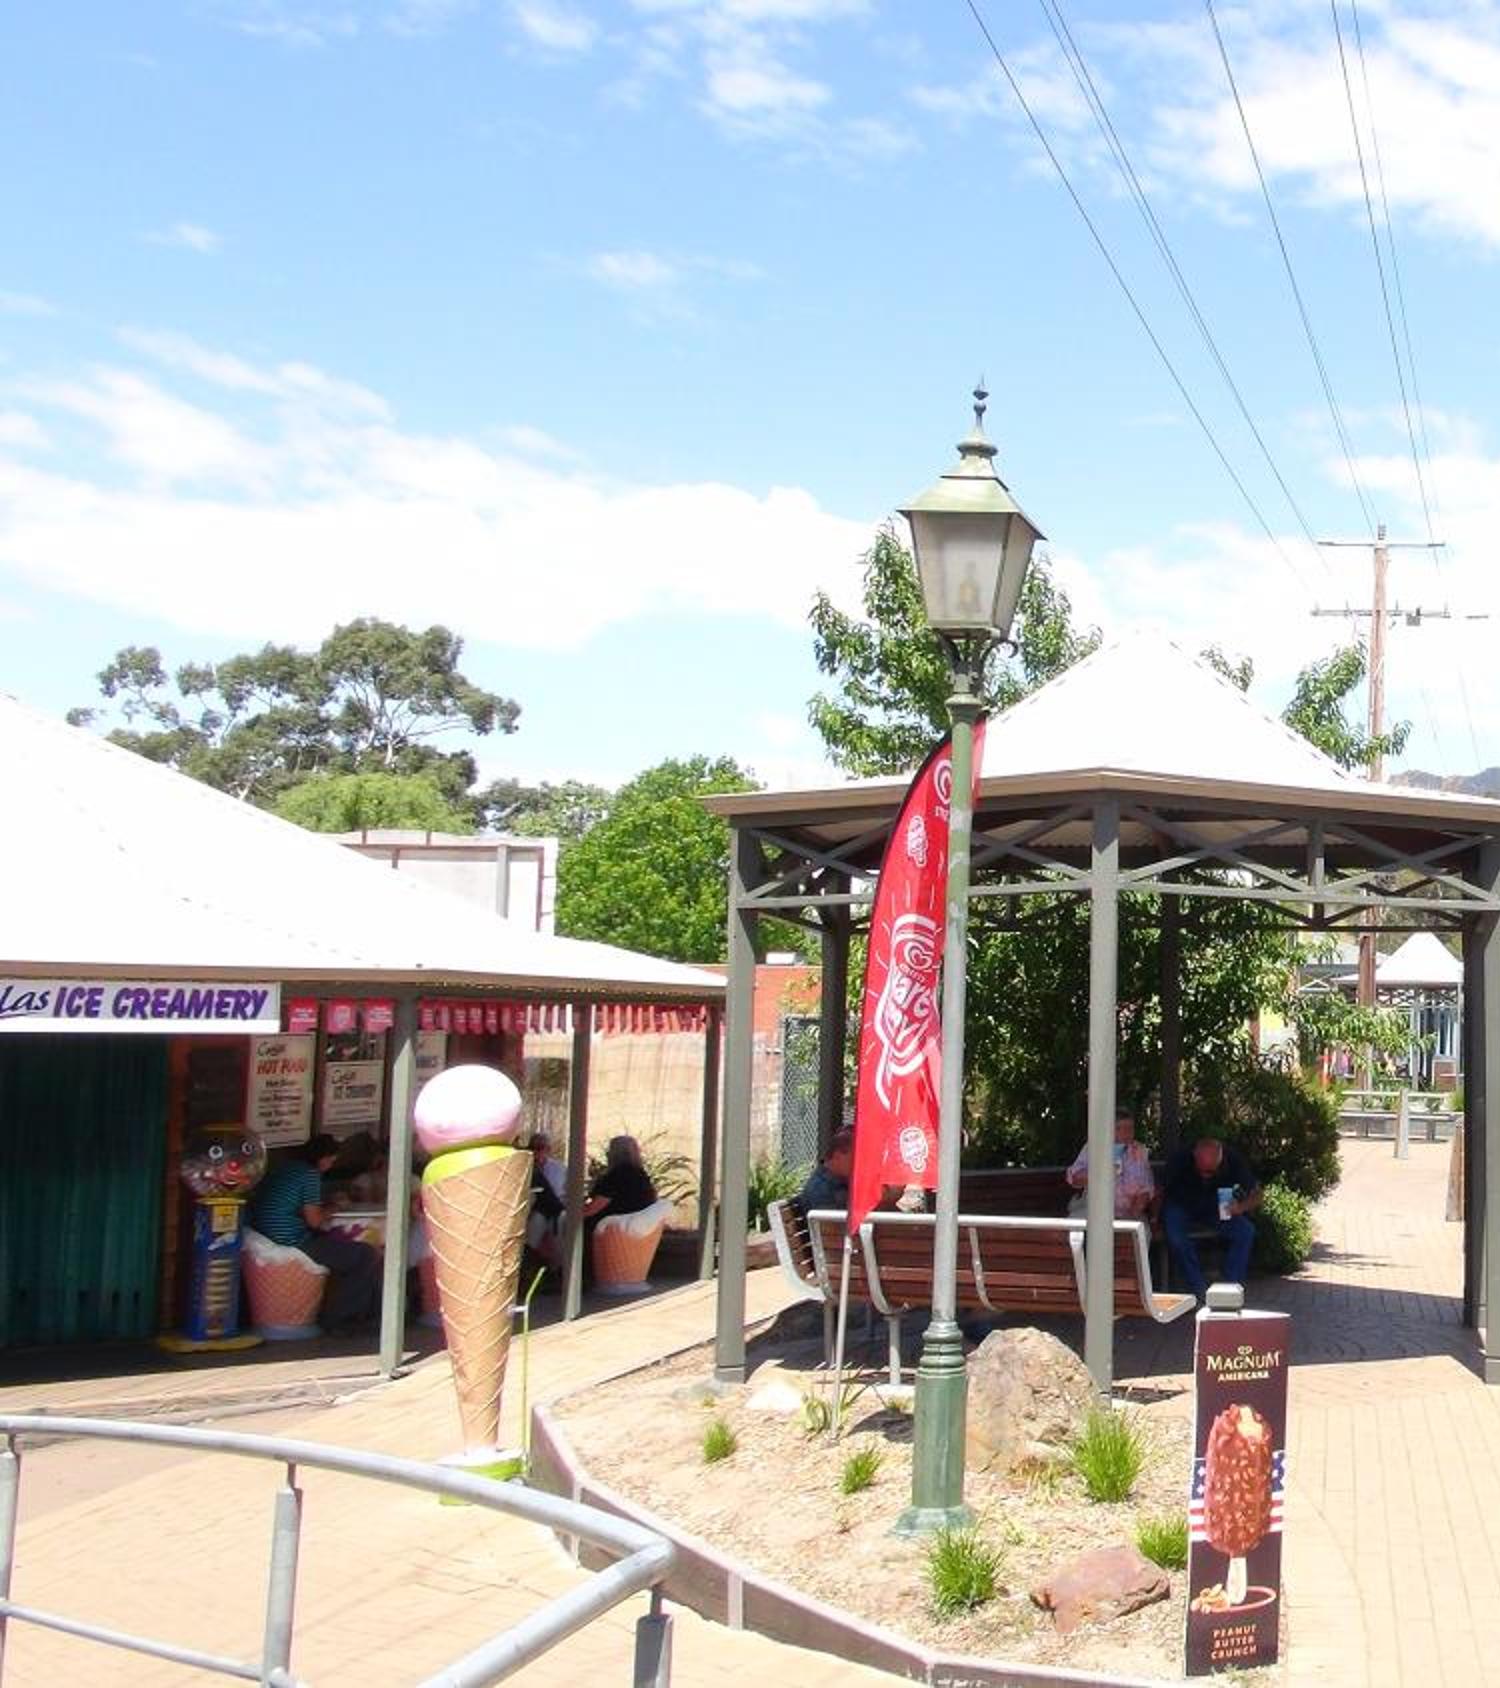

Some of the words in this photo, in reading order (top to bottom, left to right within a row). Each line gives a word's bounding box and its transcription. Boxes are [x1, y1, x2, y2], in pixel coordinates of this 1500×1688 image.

[53, 987, 104, 1019] ICE
[112, 987, 268, 1020] CREAMERY
[1206, 1350, 1281, 1371] MAGNUM
[1218, 1370, 1271, 1382] AMERICANA
[1213, 1624, 1256, 1638] PEANUT
[1214, 1635, 1255, 1649] BUTTER
[1211, 1645, 1257, 1660] CRUNCH
